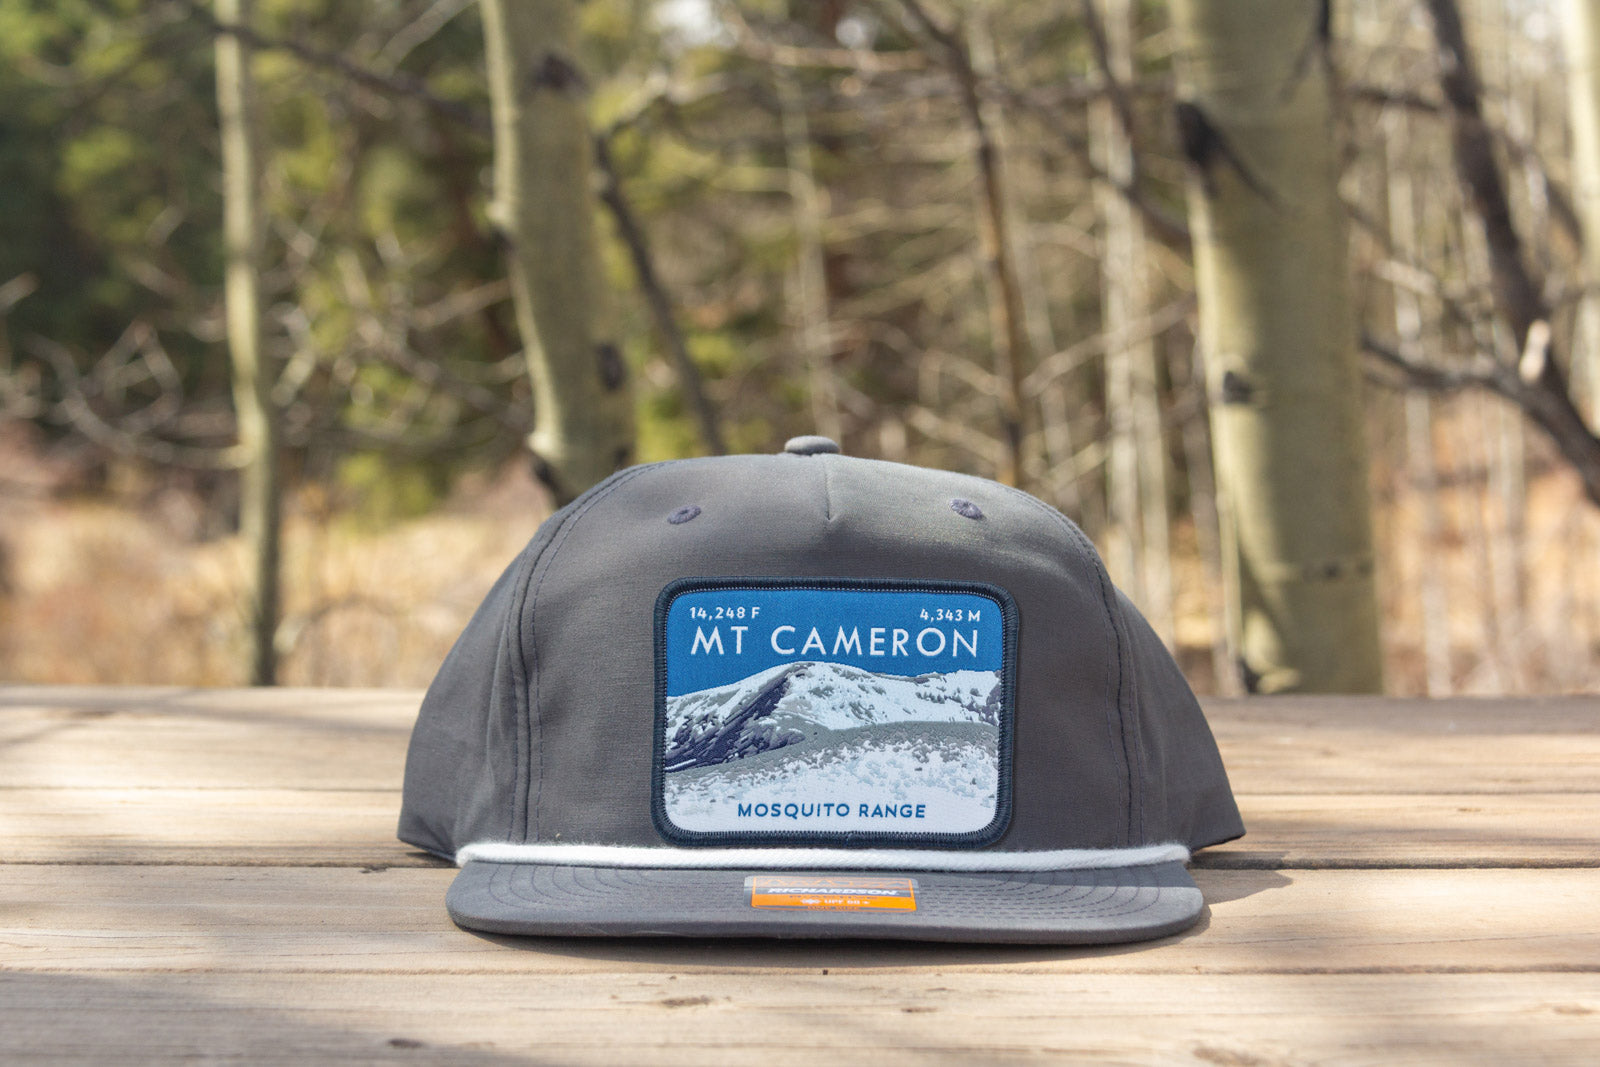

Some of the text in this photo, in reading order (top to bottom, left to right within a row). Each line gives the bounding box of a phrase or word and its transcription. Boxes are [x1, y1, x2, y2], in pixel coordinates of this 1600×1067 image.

[690, 606, 761, 620] 14,248 F
[920, 608, 981, 622] 4,343 M
[690, 625, 979, 657] MT CAMERON
[737, 803, 926, 820] MOSQUITO RANGE
[767, 887, 899, 896] RICHARDSON
